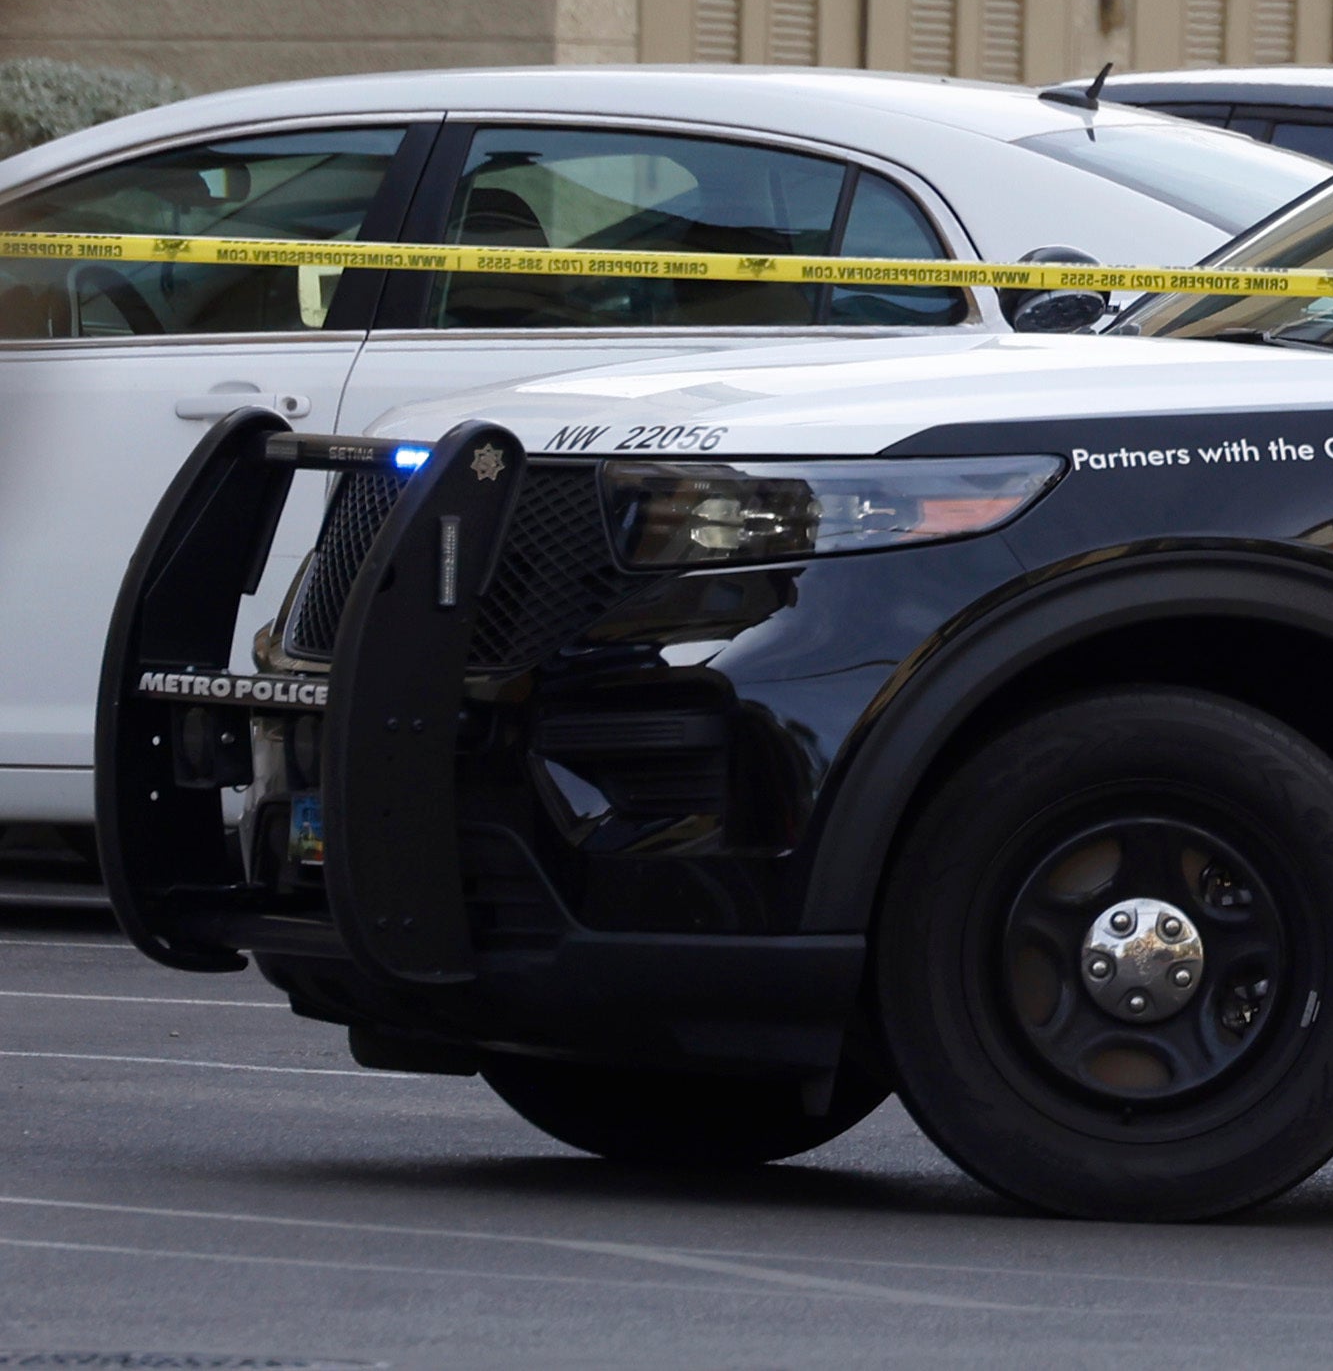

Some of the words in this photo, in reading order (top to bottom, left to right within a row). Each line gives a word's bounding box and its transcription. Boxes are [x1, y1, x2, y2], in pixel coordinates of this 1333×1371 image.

[543, 425, 611, 451] NW
[614, 425, 729, 451] 22056
[1072, 444, 1191, 472] Partners
[1198, 438, 1260, 464] with
[1268, 437, 1315, 463] the
[138, 672, 231, 698] METRO
[235, 679, 329, 706] POLICE
